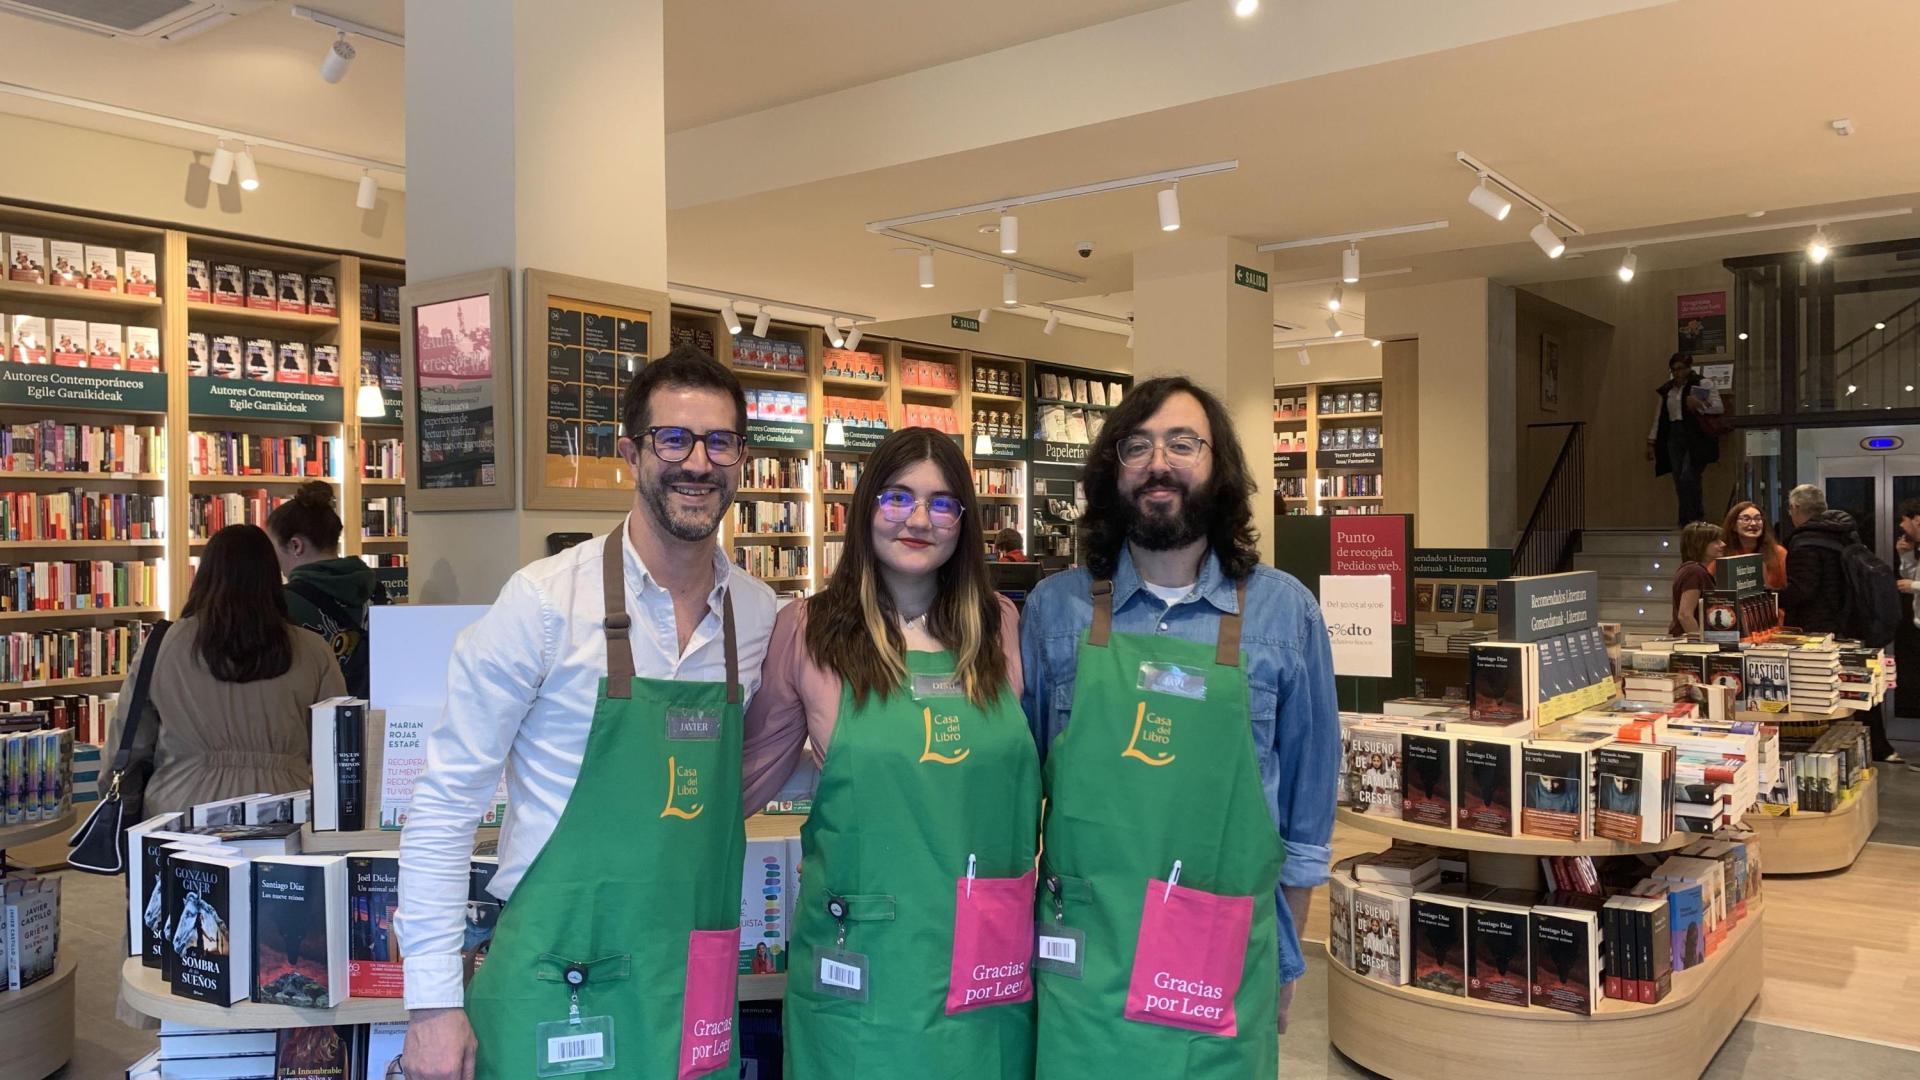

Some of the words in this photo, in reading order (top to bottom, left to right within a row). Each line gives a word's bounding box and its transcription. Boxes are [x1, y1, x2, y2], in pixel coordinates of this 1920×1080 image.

[1246, 272, 1266, 288] SALIDA
[3, 370, 48, 382] Autores
[50, 373, 144, 390] Contemporáneos
[27, 386, 56, 399] Egile
[58, 388, 123, 401] Garaikideak
[210, 385, 246, 397] Autores
[248, 388, 324, 402] Contemporáneos
[229, 399, 253, 411] Egile
[254, 400, 308, 413] Garaikideak
[424, 414, 460, 430] experiencia
[1046, 444, 1084, 462] Papelería
[1337, 532, 1375, 544] Punto
[1337, 548, 1348, 557] de
[1350, 547, 1393, 560] recogida
[1448, 555, 1487, 563] Literatura
[1337, 561, 1376, 571] Pedidos
[1378, 560, 1402, 572] web.
[1449, 565, 1488, 573] Literatura
[1532, 590, 1566, 608] Recomendados
[1566, 588, 1587, 603] Literatura
[1532, 611, 1564, 632] Gomendatuak
[1566, 610, 1588, 624] Literatura
[1749, 663, 1785, 680] CASTIGO
[934, 714, 959, 724] Casa
[1146, 712, 1172, 726] Casa
[680, 722, 708, 732] JAVIER
[947, 724, 960, 732] del
[1157, 726, 1170, 735] del
[389, 740, 420, 748] ESTAPÉ
[936, 732, 960, 742] Libro
[1143, 730, 1170, 744] Libro
[1352, 740, 1364, 752] EL
[1409, 744, 1426, 754] Santiago
[1466, 751, 1485, 760] Santiago
[1356, 756, 1366, 768] DE
[1386, 760, 1396, 772] LA
[677, 766, 697, 777] Casa
[688, 778, 698, 786] del
[1362, 774, 1398, 790] FAMILIA
[678, 786, 698, 796] Libro
[1360, 790, 1392, 805] CRESPI
[175, 867, 218, 884] GONZALO
[357, 874, 371, 882] Joël
[372, 874, 397, 882] Dicker
[182, 880, 211, 894] GINER
[262, 880, 288, 892] Santiago
[290, 882, 304, 892] Díaz
[26, 902, 48, 916] JAVIER
[1356, 901, 1364, 914] EL
[1418, 910, 1438, 919] Santiago
[21, 909, 52, 926] CASTILLO
[742, 920, 763, 928] UISTA
[1478, 919, 1499, 928] Santiago
[24, 924, 48, 940] GRIETA
[1358, 918, 1367, 932] DE
[1382, 926, 1392, 940] LA
[1539, 925, 1560, 935] Santiago
[1363, 938, 1394, 957] FAMILIA
[182, 956, 220, 974] SOMBRA
[1362, 954, 1389, 971] CRESPI
[973, 962, 1024, 980] Gracias
[182, 971, 216, 990] SUEÑOS
[1154, 972, 1222, 1000] Gracias
[964, 986, 992, 1004] por
[994, 980, 1024, 997] Leer
[1144, 994, 1179, 1012] por
[1181, 997, 1224, 1020] Leer
[694, 1017, 732, 1036] Gracias
[691, 1044, 712, 1066] por
[713, 1039, 732, 1056] Leer
